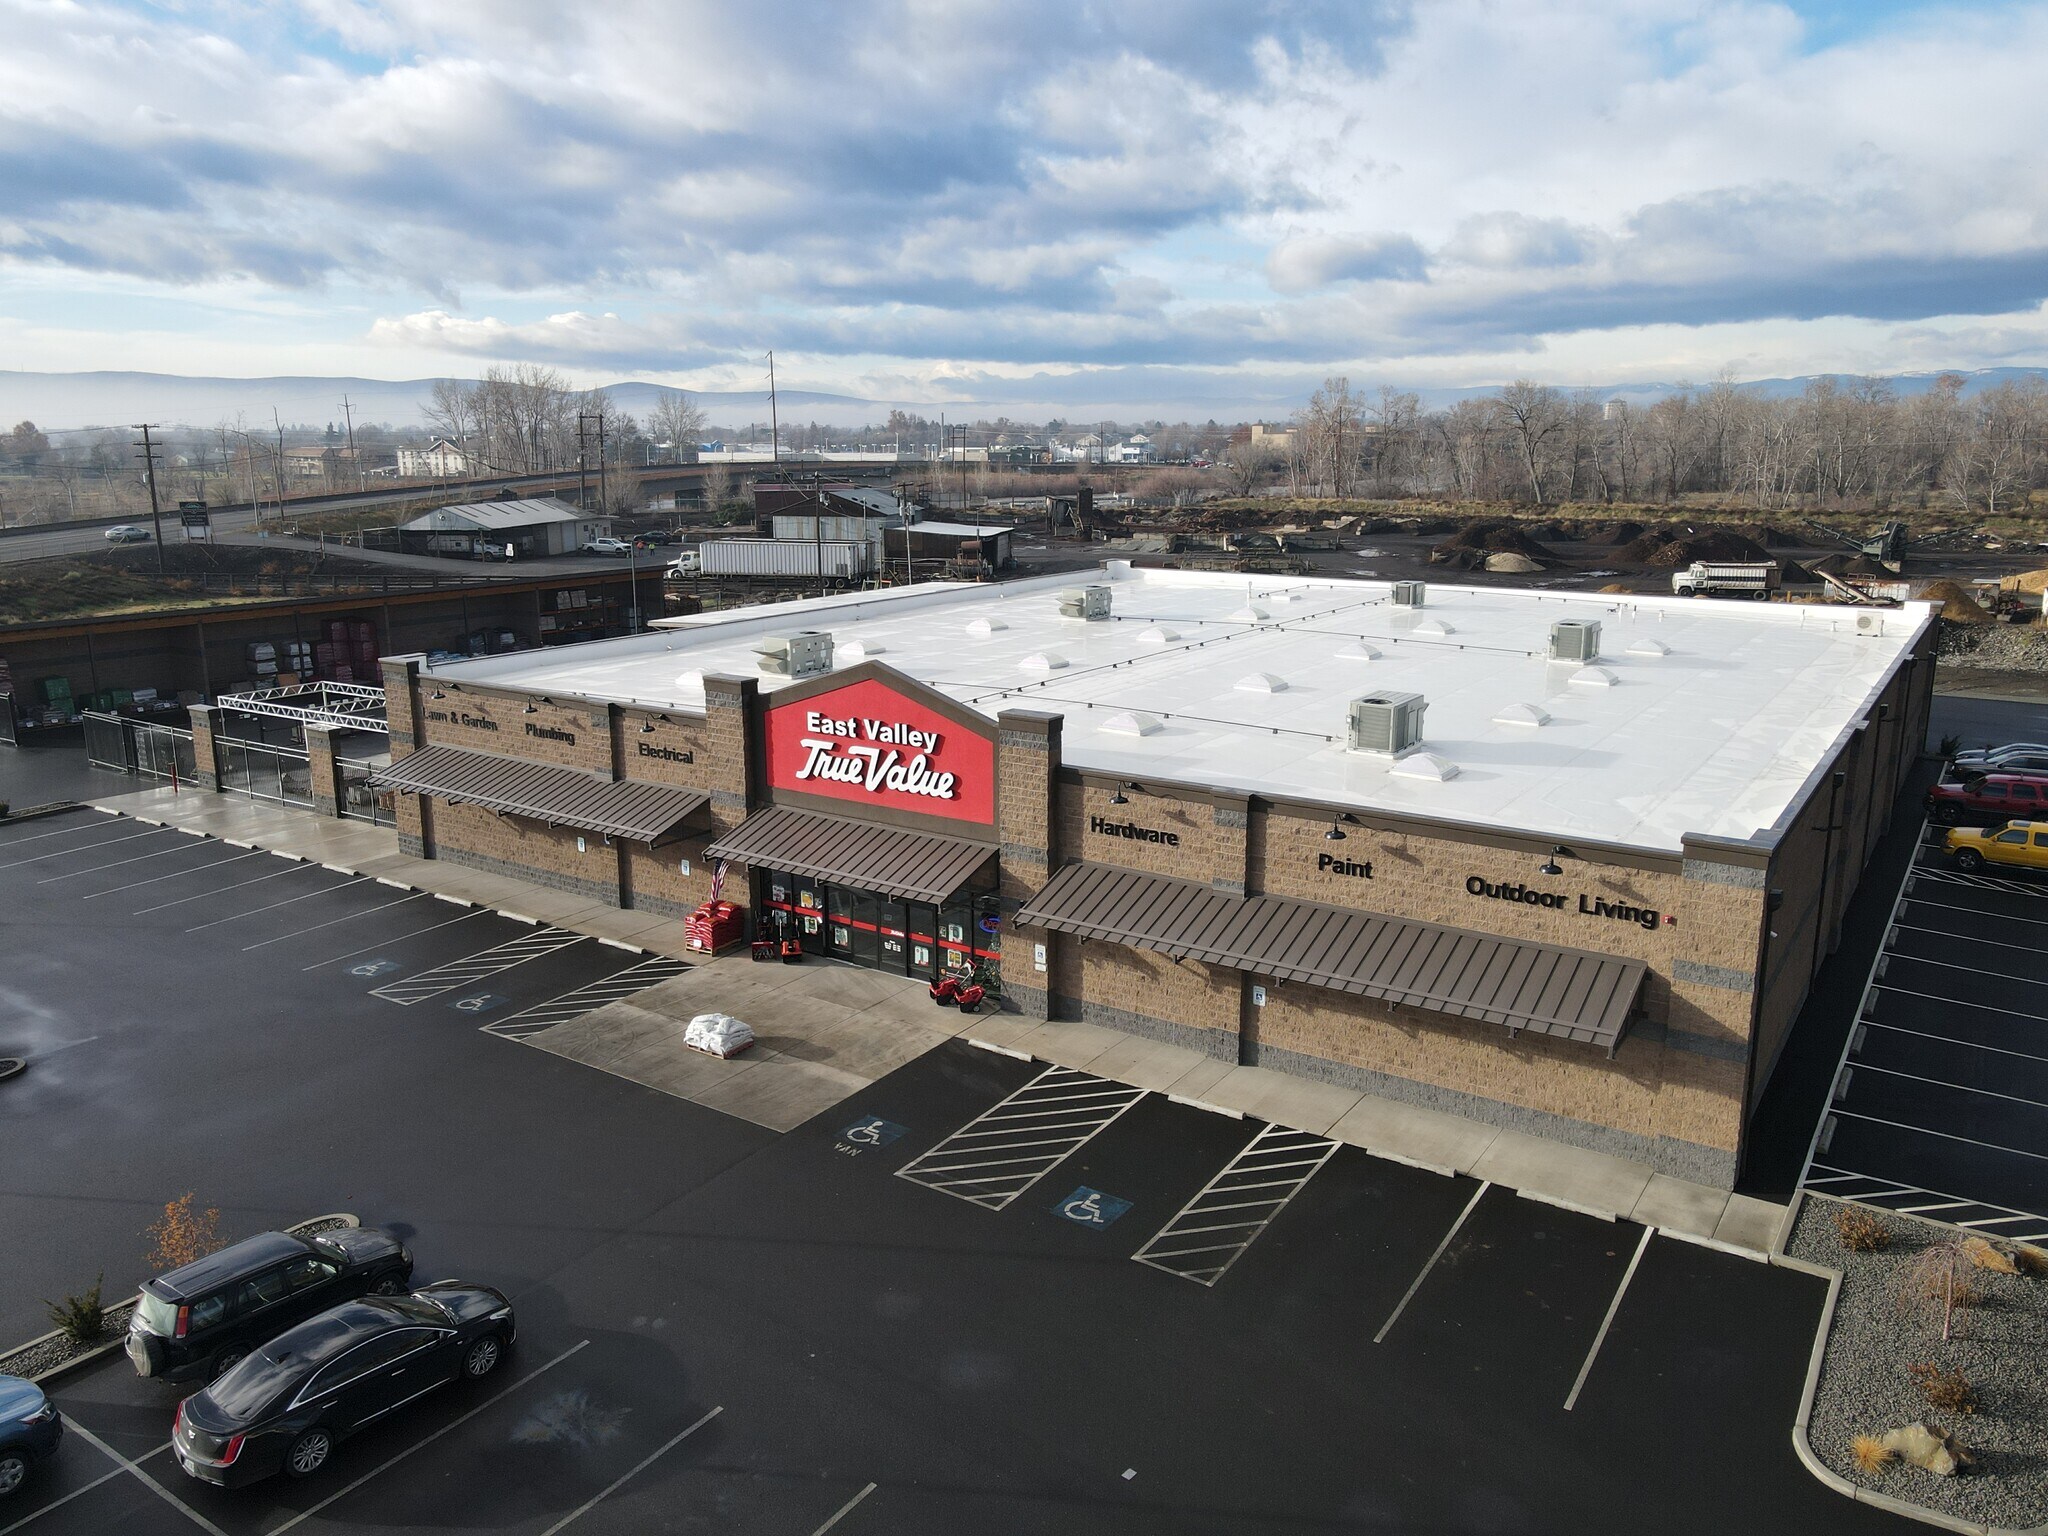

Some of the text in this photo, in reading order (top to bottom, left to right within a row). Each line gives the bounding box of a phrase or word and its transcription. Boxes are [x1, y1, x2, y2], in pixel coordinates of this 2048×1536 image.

[422, 706, 498, 731] Lawn & Garden
[525, 723, 576, 746] Plumbing
[807, 711, 937, 754] East Valley
[638, 742, 694, 764] Electrical
[1091, 816, 1179, 846] Hardware
[1318, 853, 1373, 879] Paint
[1466, 876, 1660, 930] Outdoor Living
